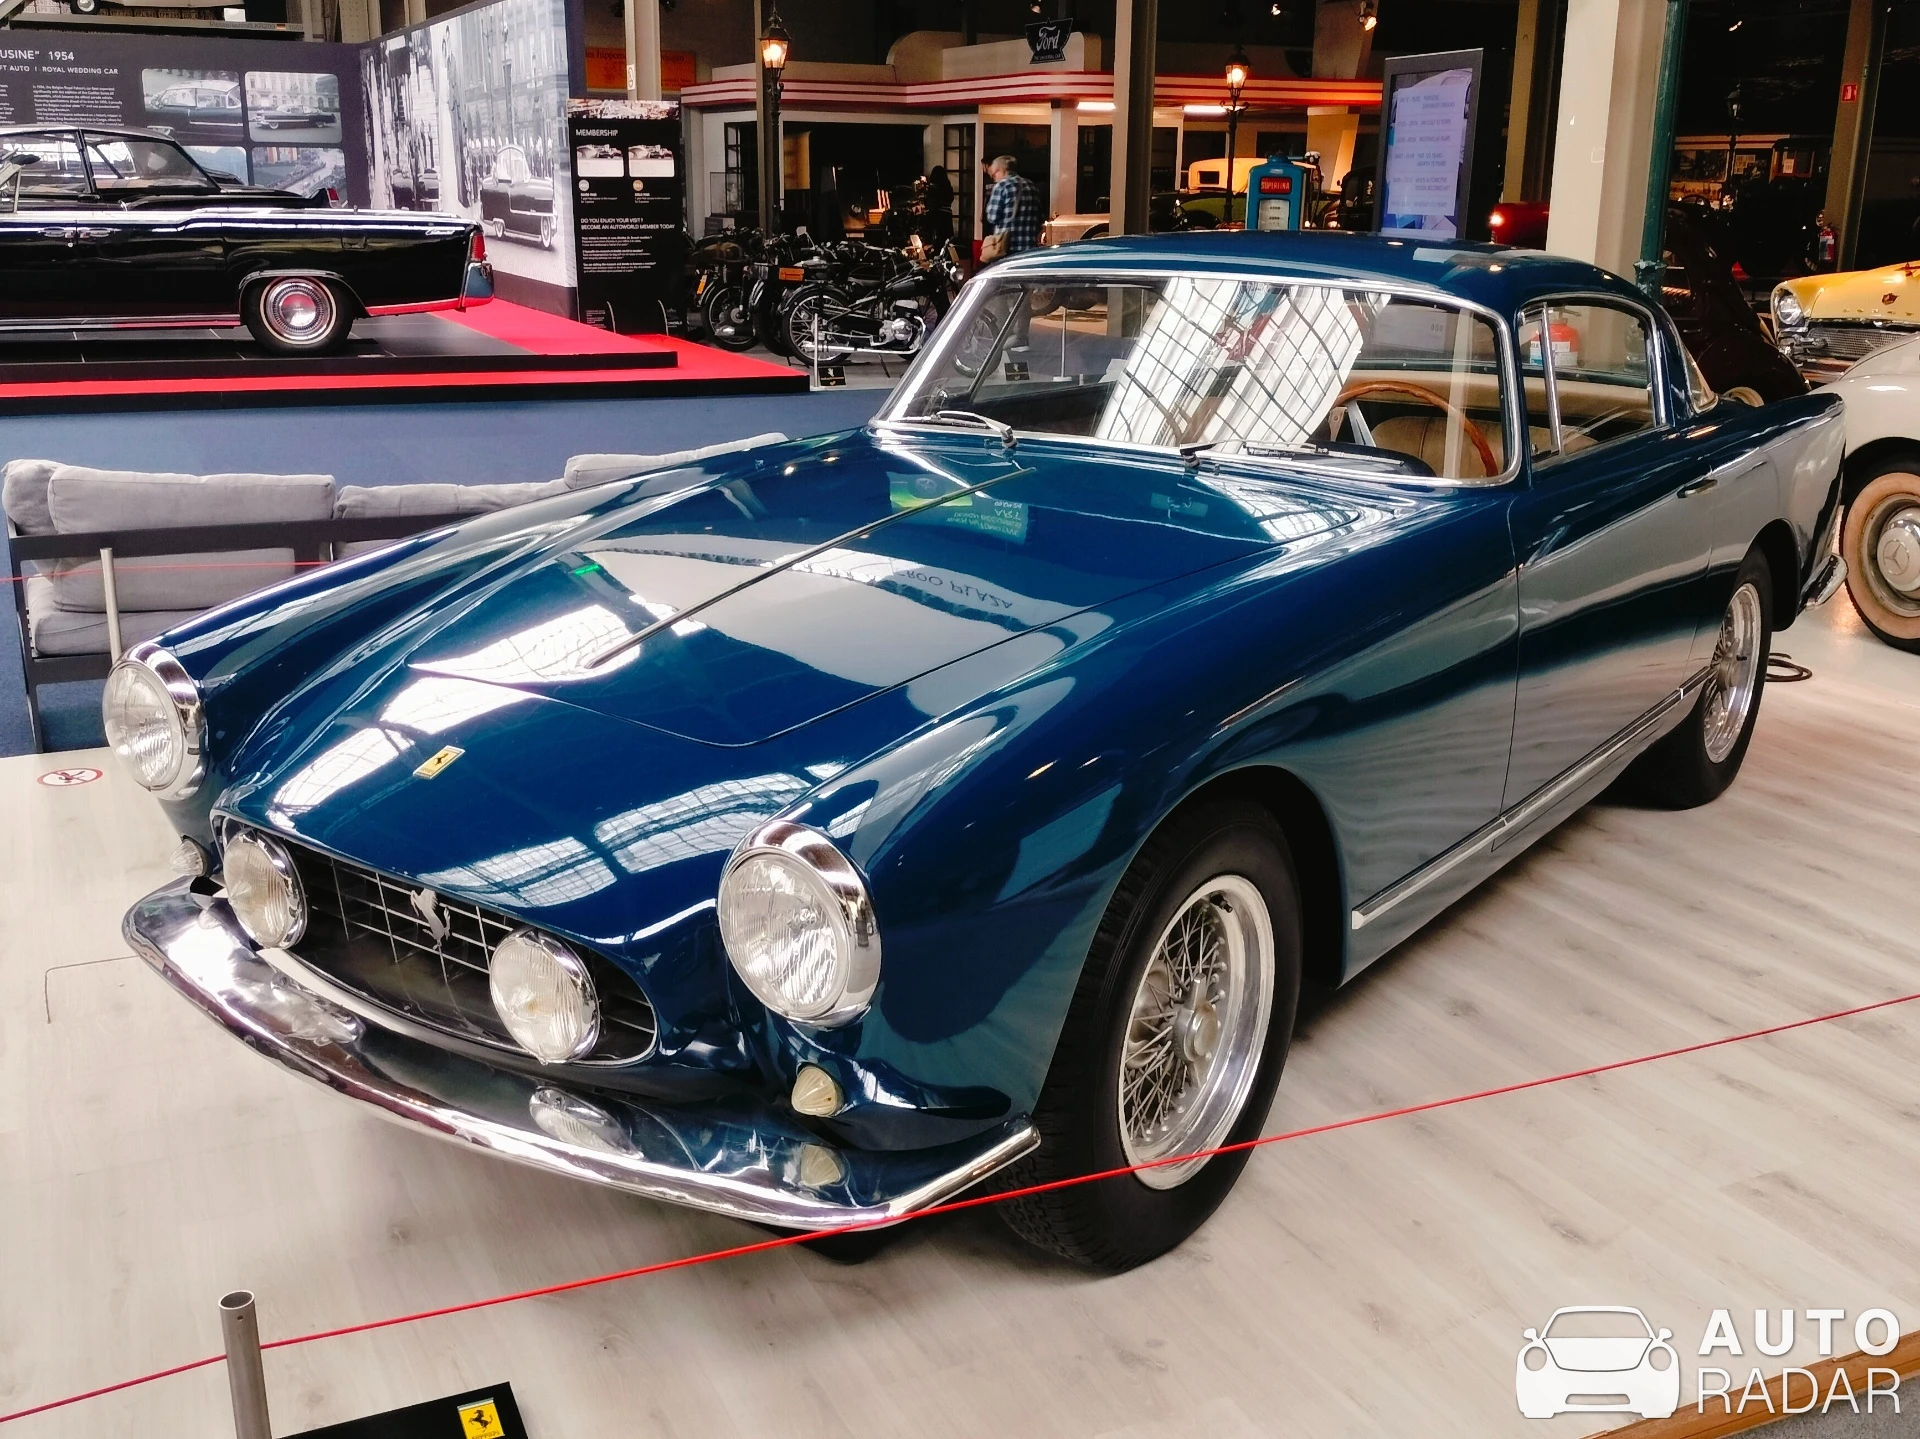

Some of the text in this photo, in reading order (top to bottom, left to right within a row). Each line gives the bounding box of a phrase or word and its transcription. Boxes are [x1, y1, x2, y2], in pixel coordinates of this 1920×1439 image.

[1036, 26, 1060, 51] Ford
[48, 50, 75, 61] 1954
[575, 128, 619, 137] MEMBERSHIP
